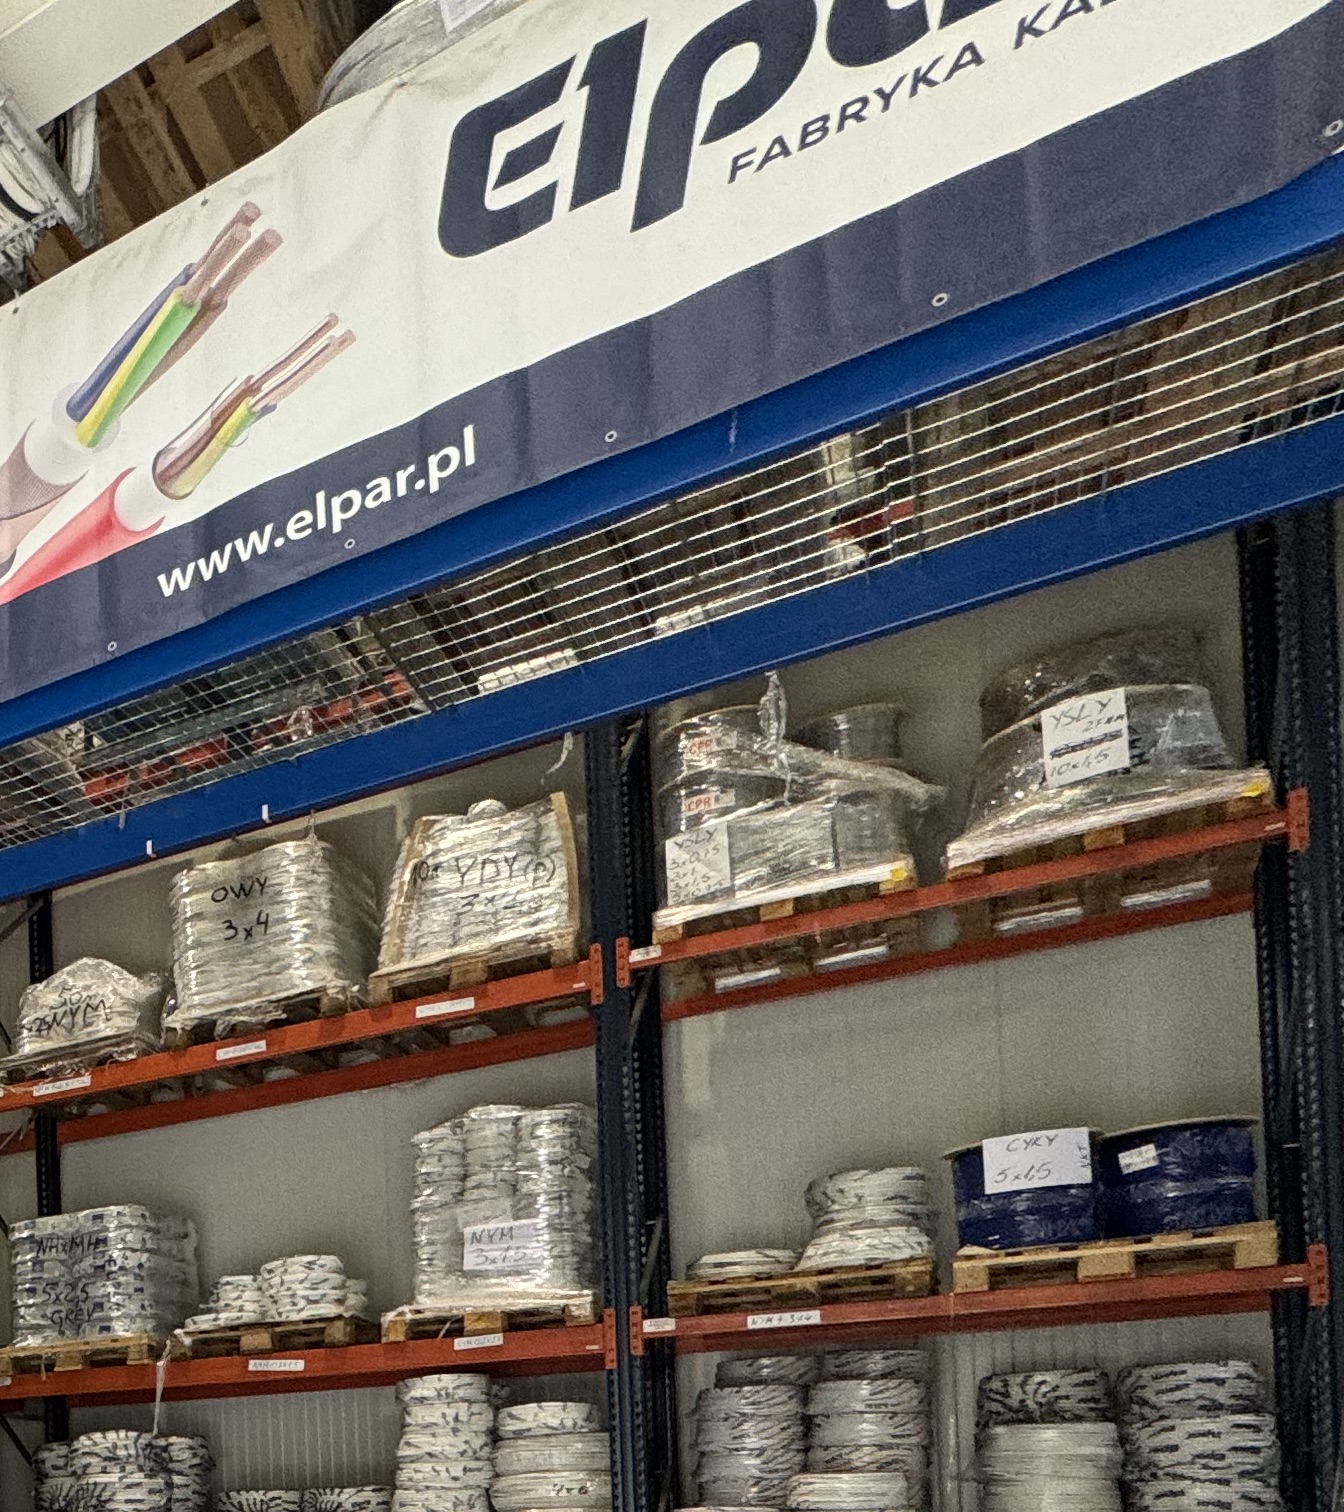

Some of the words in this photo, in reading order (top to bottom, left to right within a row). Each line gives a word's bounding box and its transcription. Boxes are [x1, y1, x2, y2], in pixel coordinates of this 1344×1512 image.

[727, 41, 986, 184] FABRYKA
[157, 424, 476, 598] www.elpar.pl
[210, 877, 268, 904] OWY
[221, 909, 270, 941] 3x4
